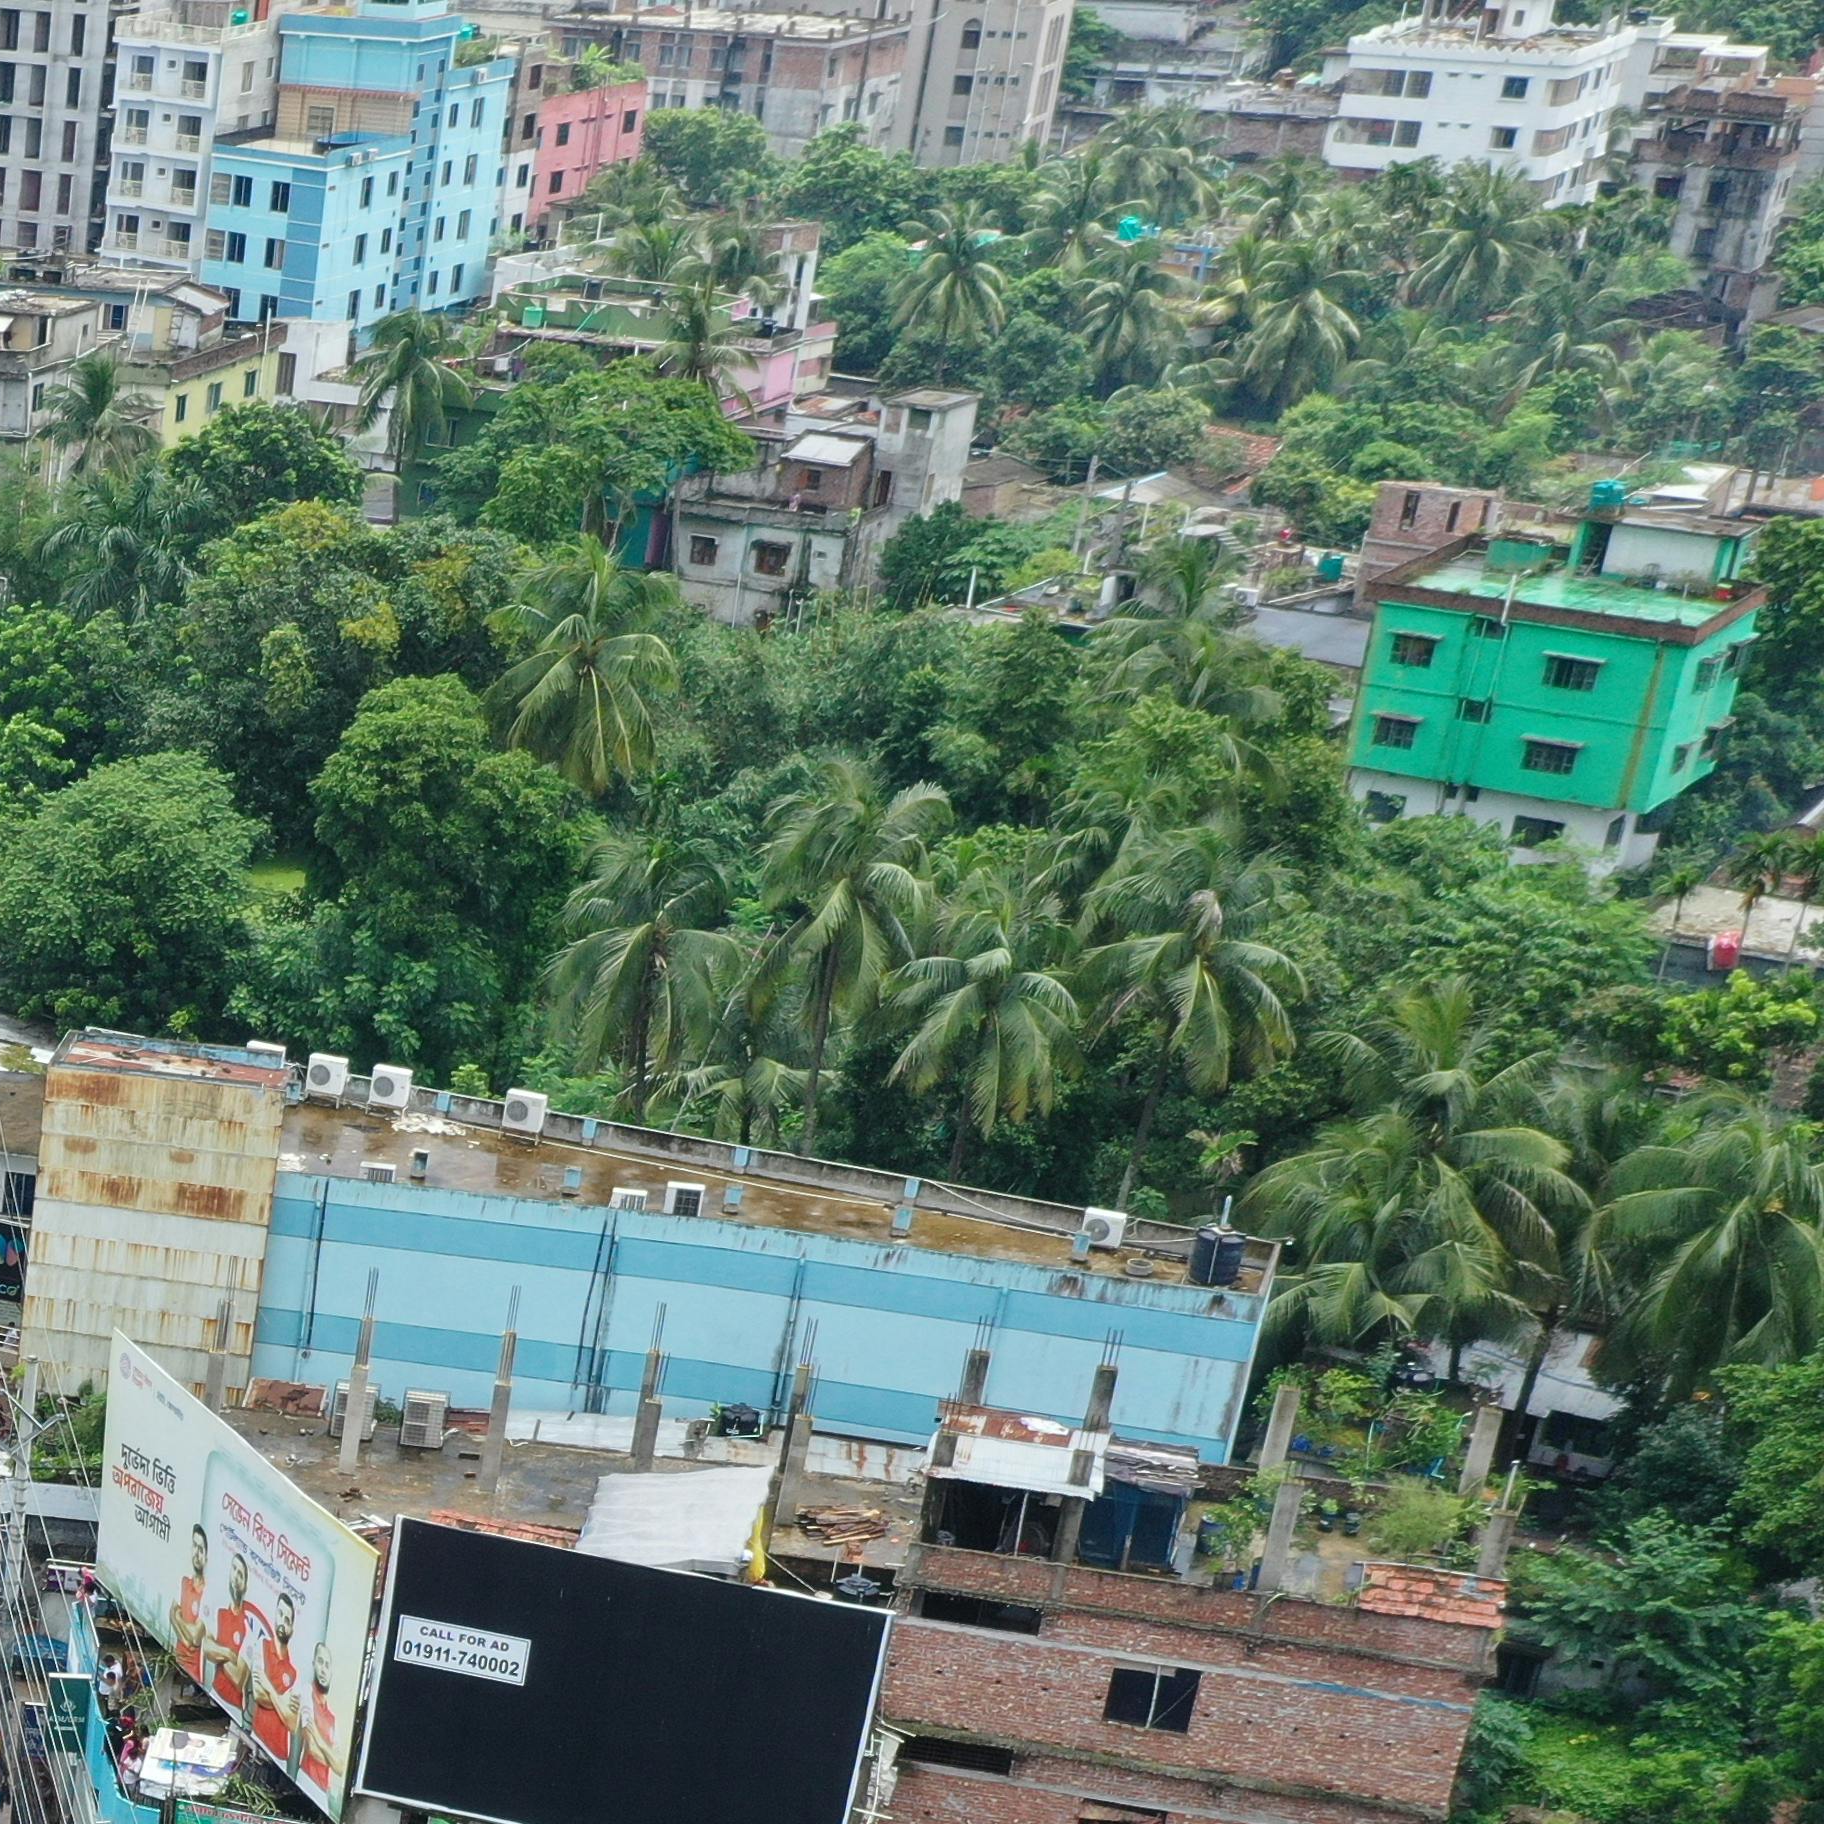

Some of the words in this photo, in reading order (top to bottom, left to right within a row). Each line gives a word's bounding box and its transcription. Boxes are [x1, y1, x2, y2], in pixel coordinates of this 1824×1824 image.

[112, 1465, 165, 1514] অপরাজেয়
[152, 1456, 177, 1495] ভিত্তি
[134, 1504, 171, 1543] আগামী
[222, 1492, 251, 1531] সেভেন
[277, 1534, 312, 1582] সিমেন্ট
[402, 1640, 520, 1677] 01911-740002
[420, 1626, 454, 1641] CALL
[458, 1633, 487, 1648] FOR
[490, 1640, 510, 1652] AD
